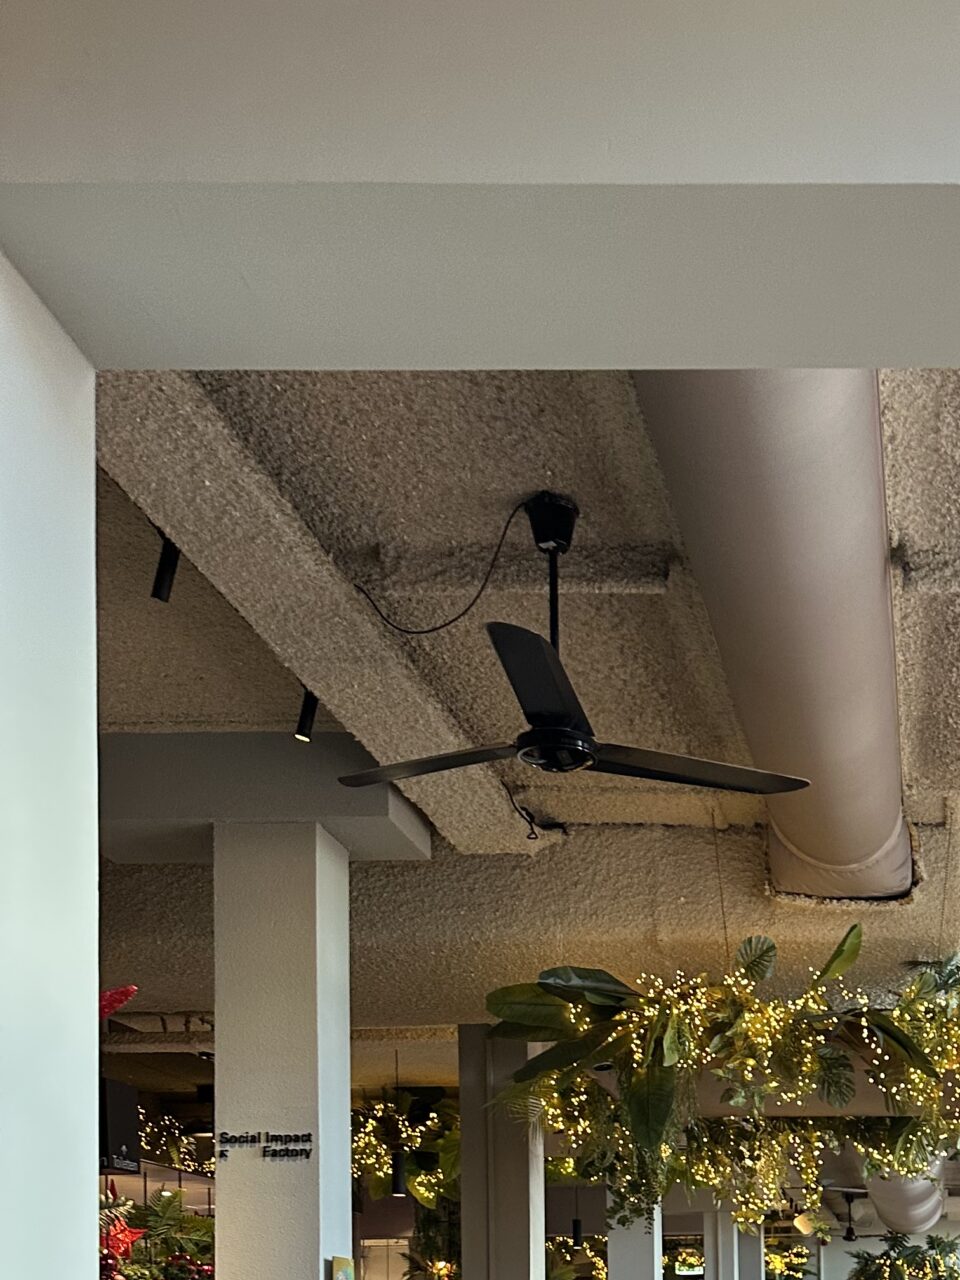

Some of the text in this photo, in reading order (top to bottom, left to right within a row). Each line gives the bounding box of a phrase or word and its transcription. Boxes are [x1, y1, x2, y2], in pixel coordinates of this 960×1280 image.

[219, 1131, 313, 1146] Social Impact
[262, 1145, 313, 1160] Factory
